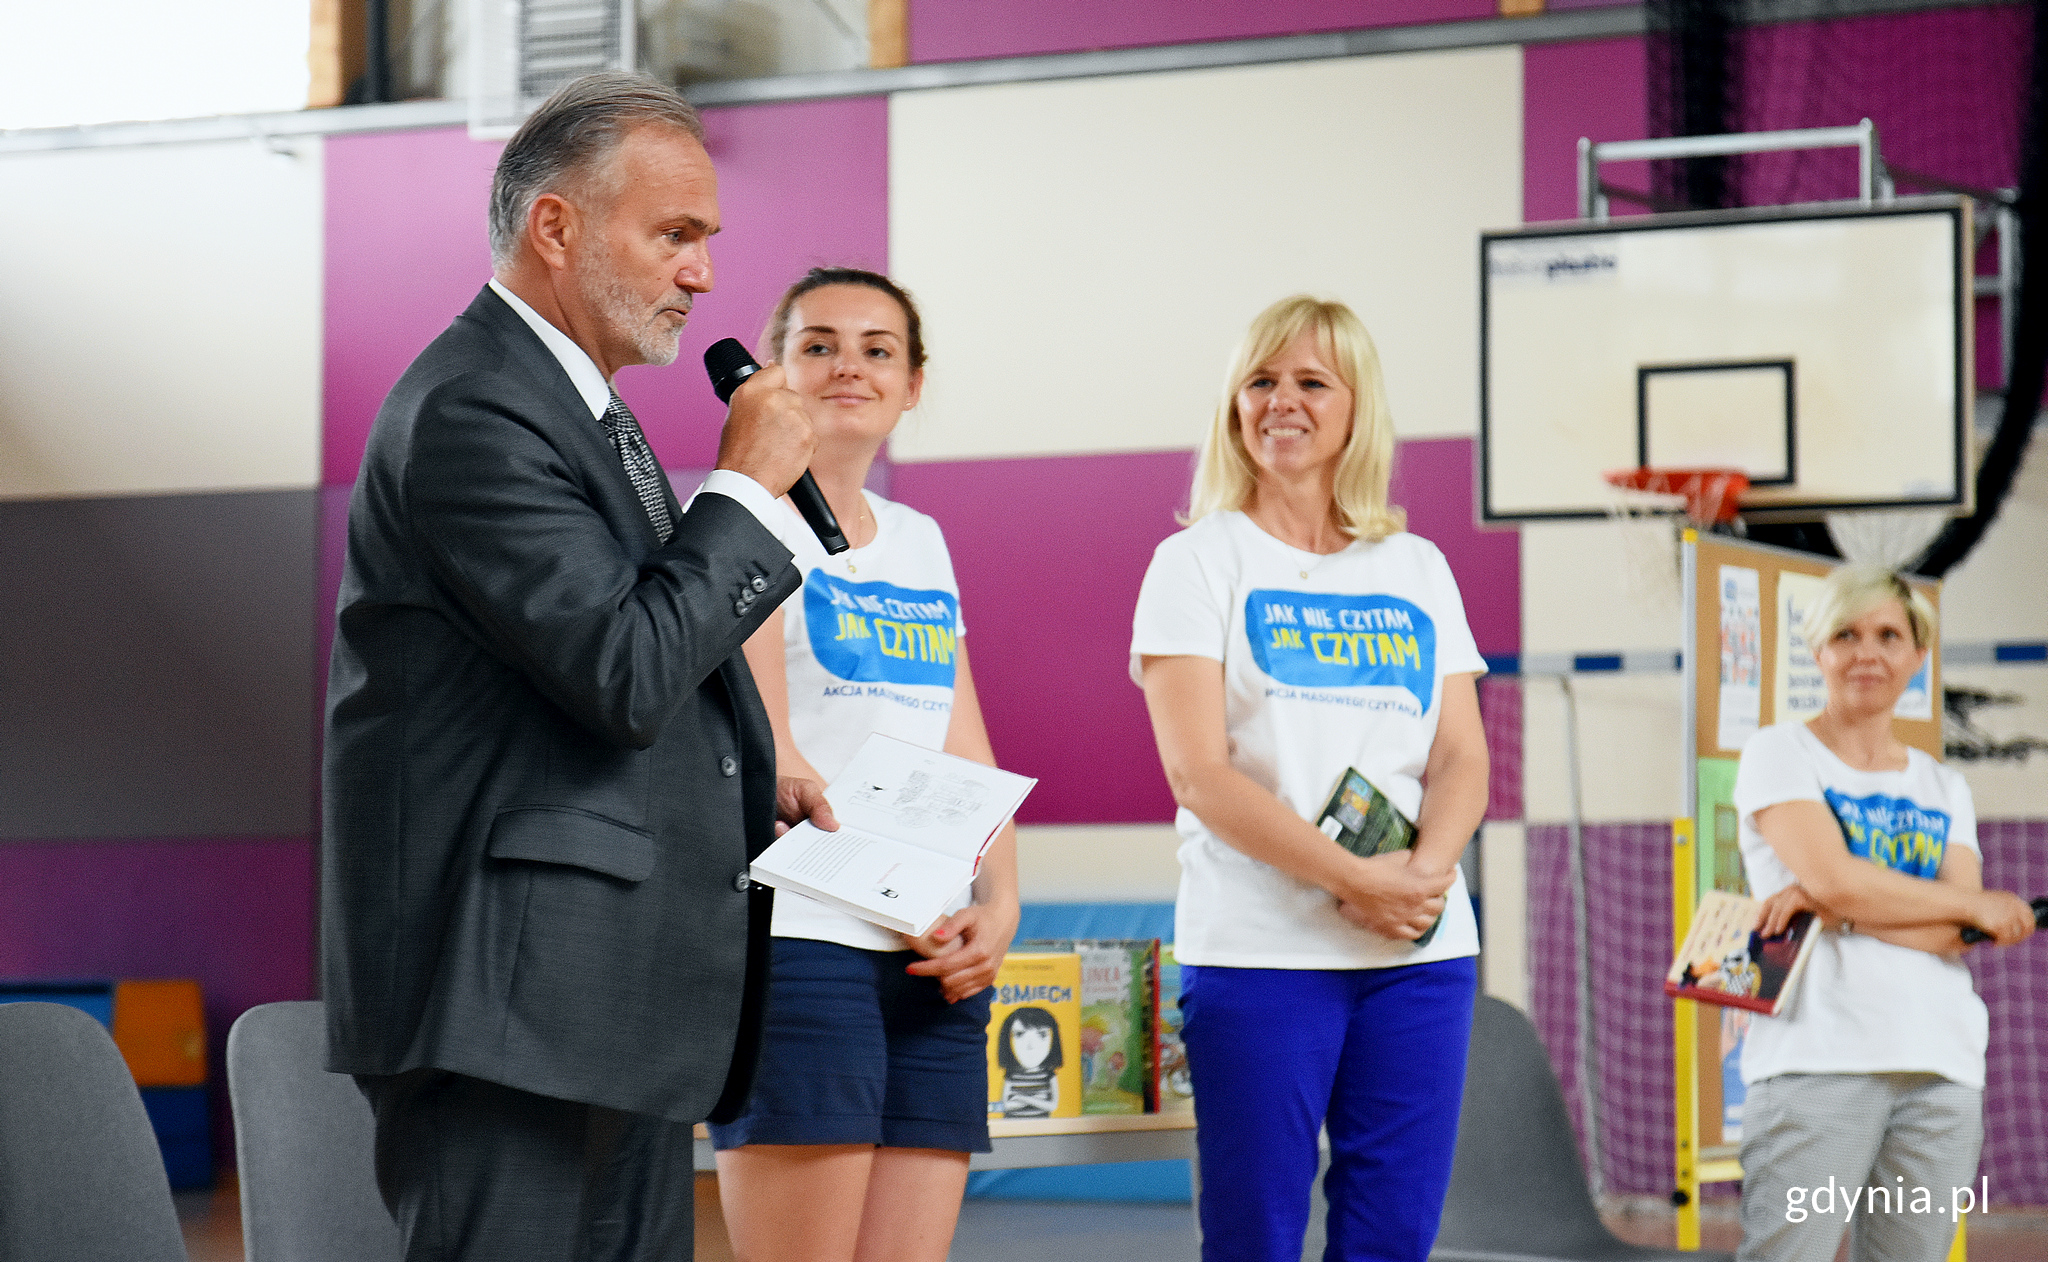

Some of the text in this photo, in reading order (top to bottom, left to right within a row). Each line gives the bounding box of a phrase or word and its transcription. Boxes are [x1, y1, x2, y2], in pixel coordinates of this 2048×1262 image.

[1264, 603, 1414, 632] JAK NIE CZYTAM
[834, 612, 957, 665] JAK CZYTAM
[1270, 627, 1422, 671] JAK CZYTAM
[822, 685, 863, 698] AKCJA
[867, 686, 920, 710] MAWEGO
[1300, 689, 1366, 708] MASOWEGO
